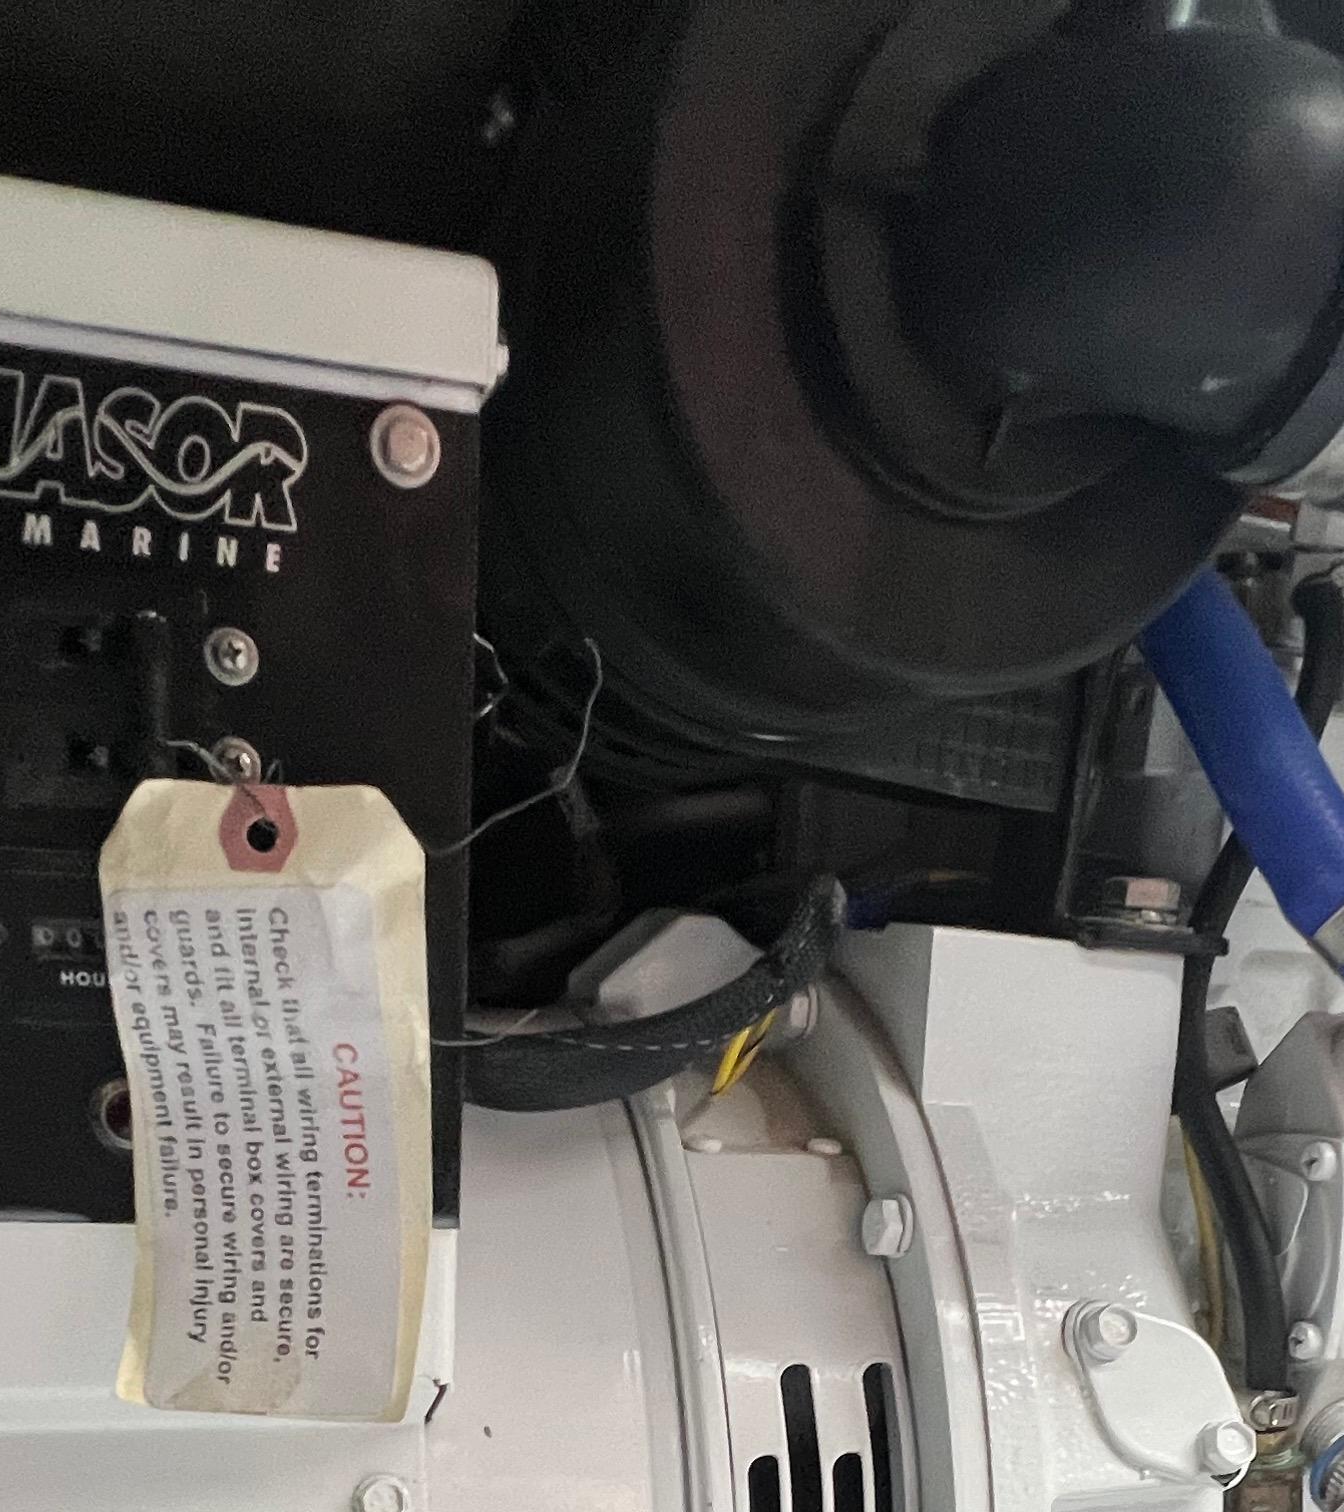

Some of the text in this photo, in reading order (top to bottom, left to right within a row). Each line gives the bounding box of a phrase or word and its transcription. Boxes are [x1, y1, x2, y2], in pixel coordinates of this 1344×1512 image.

[22, 512, 283, 574] MARINE
[60, 969, 107, 987] HOU
[113, 911, 179, 1217] and/or equipment failure.
[144, 910, 214, 1343] covers may result in personal injury
[169, 910, 242, 1385] guards. Failure to secure wiring and/or
[204, 910, 269, 1322] and fit all terminal box covers and
[237, 908, 295, 1362] internal or external wiring are secure,
[268, 907, 328, 1360] Check that all wiring terminations for
[333, 1043, 371, 1198] CAUTION:
